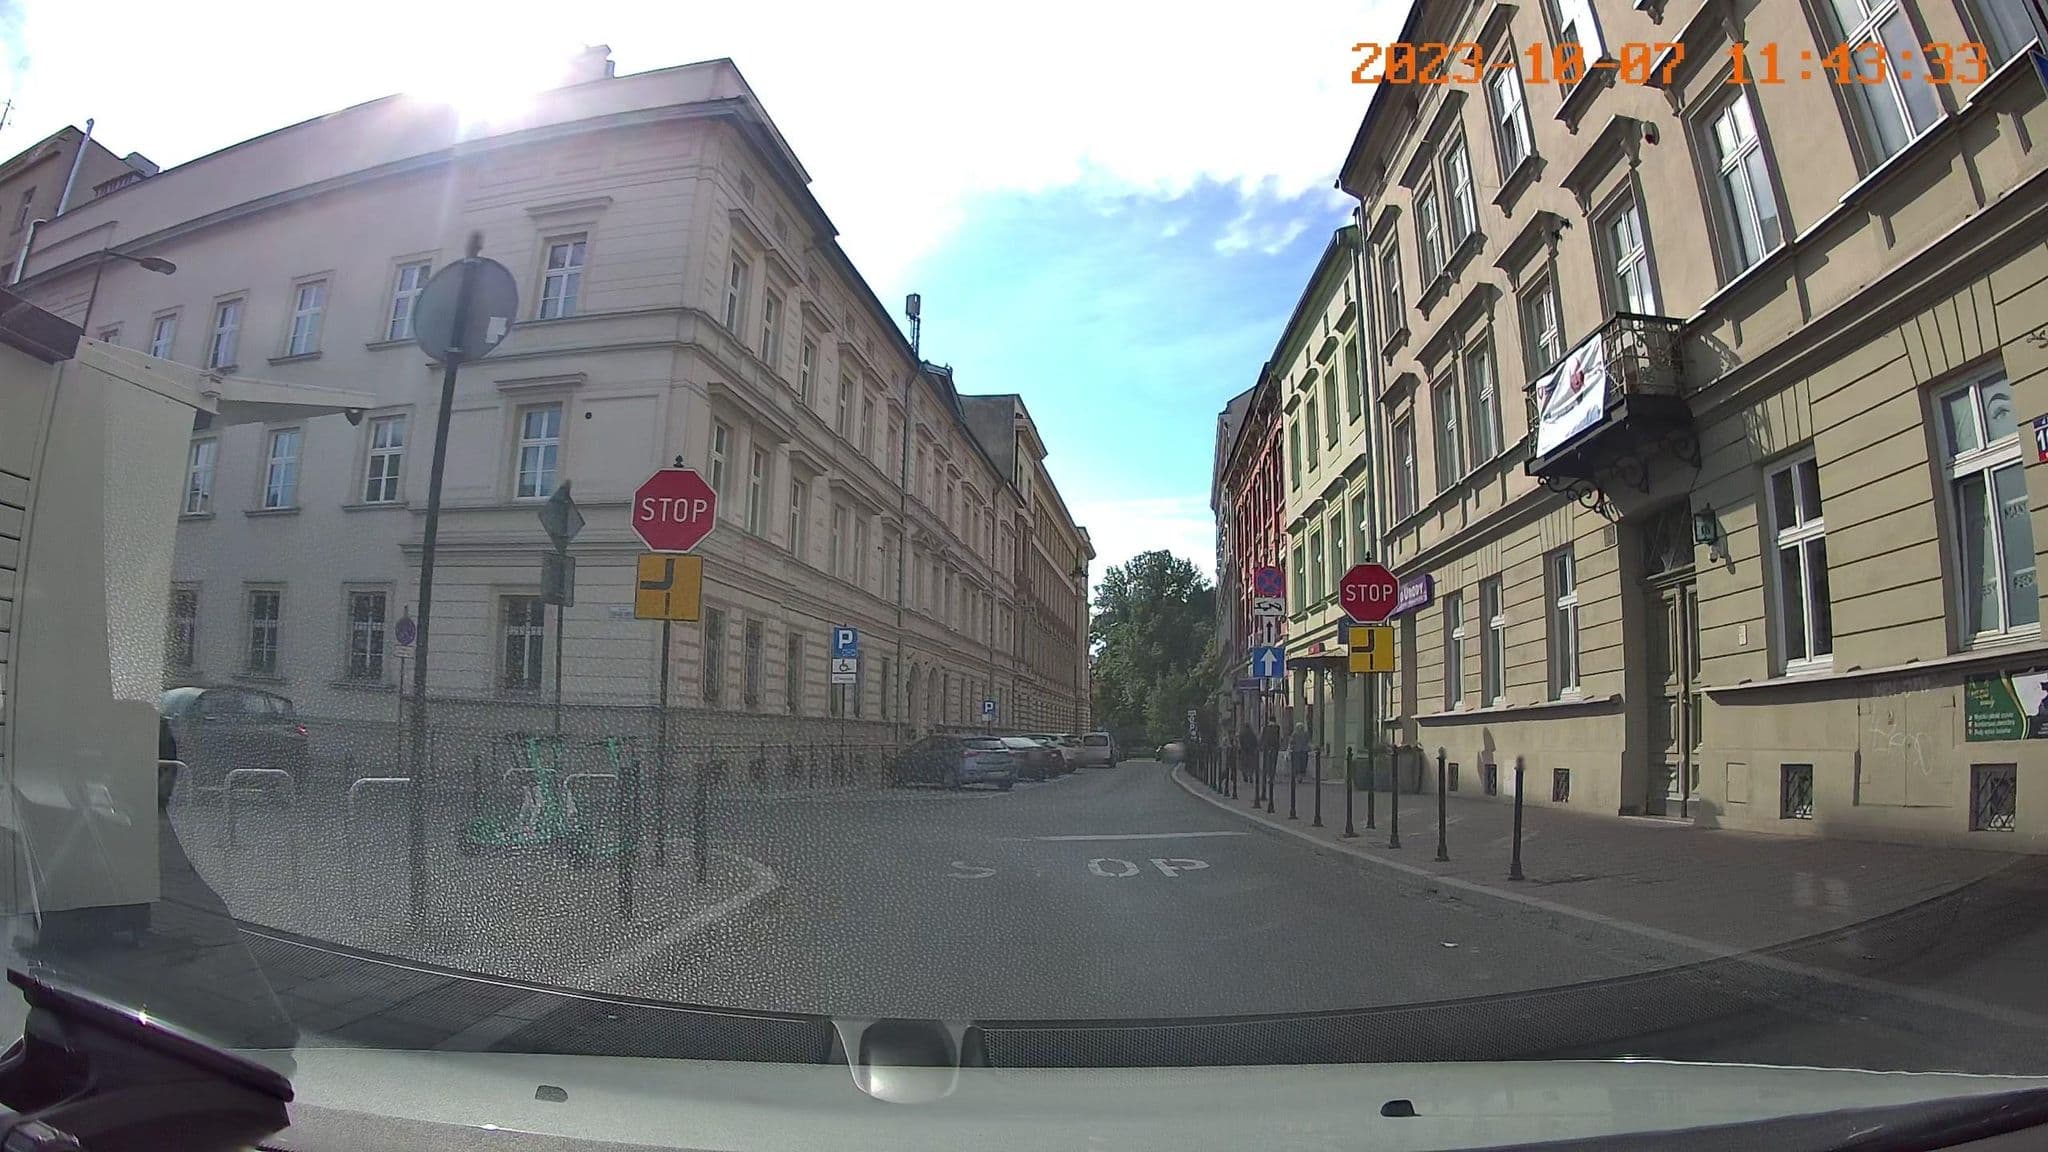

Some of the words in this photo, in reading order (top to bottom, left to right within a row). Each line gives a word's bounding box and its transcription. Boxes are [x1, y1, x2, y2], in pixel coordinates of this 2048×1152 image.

[641, 497, 708, 523] STOP
[1345, 583, 1393, 602] STOP
[838, 629, 853, 649] P
